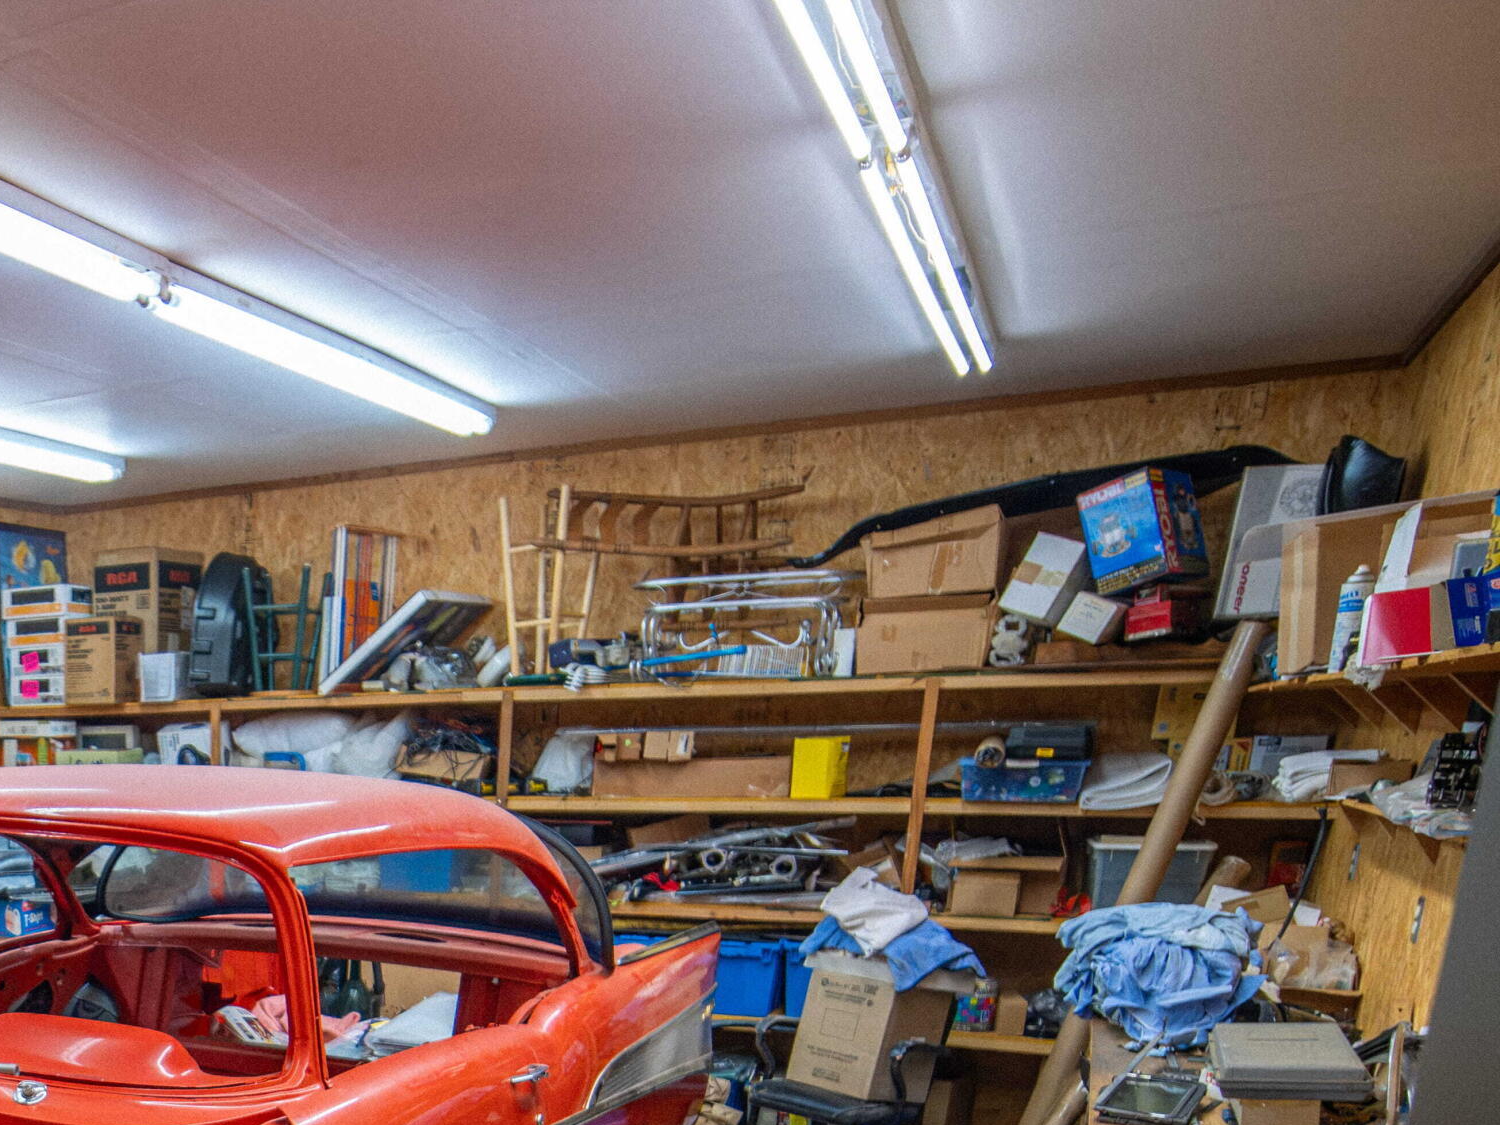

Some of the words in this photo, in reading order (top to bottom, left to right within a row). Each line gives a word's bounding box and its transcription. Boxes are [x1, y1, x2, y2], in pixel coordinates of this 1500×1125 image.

[1155, 489, 1180, 568] RYOBI
[105, 571, 138, 586] RCA
[1234, 561, 1250, 614] oneer
